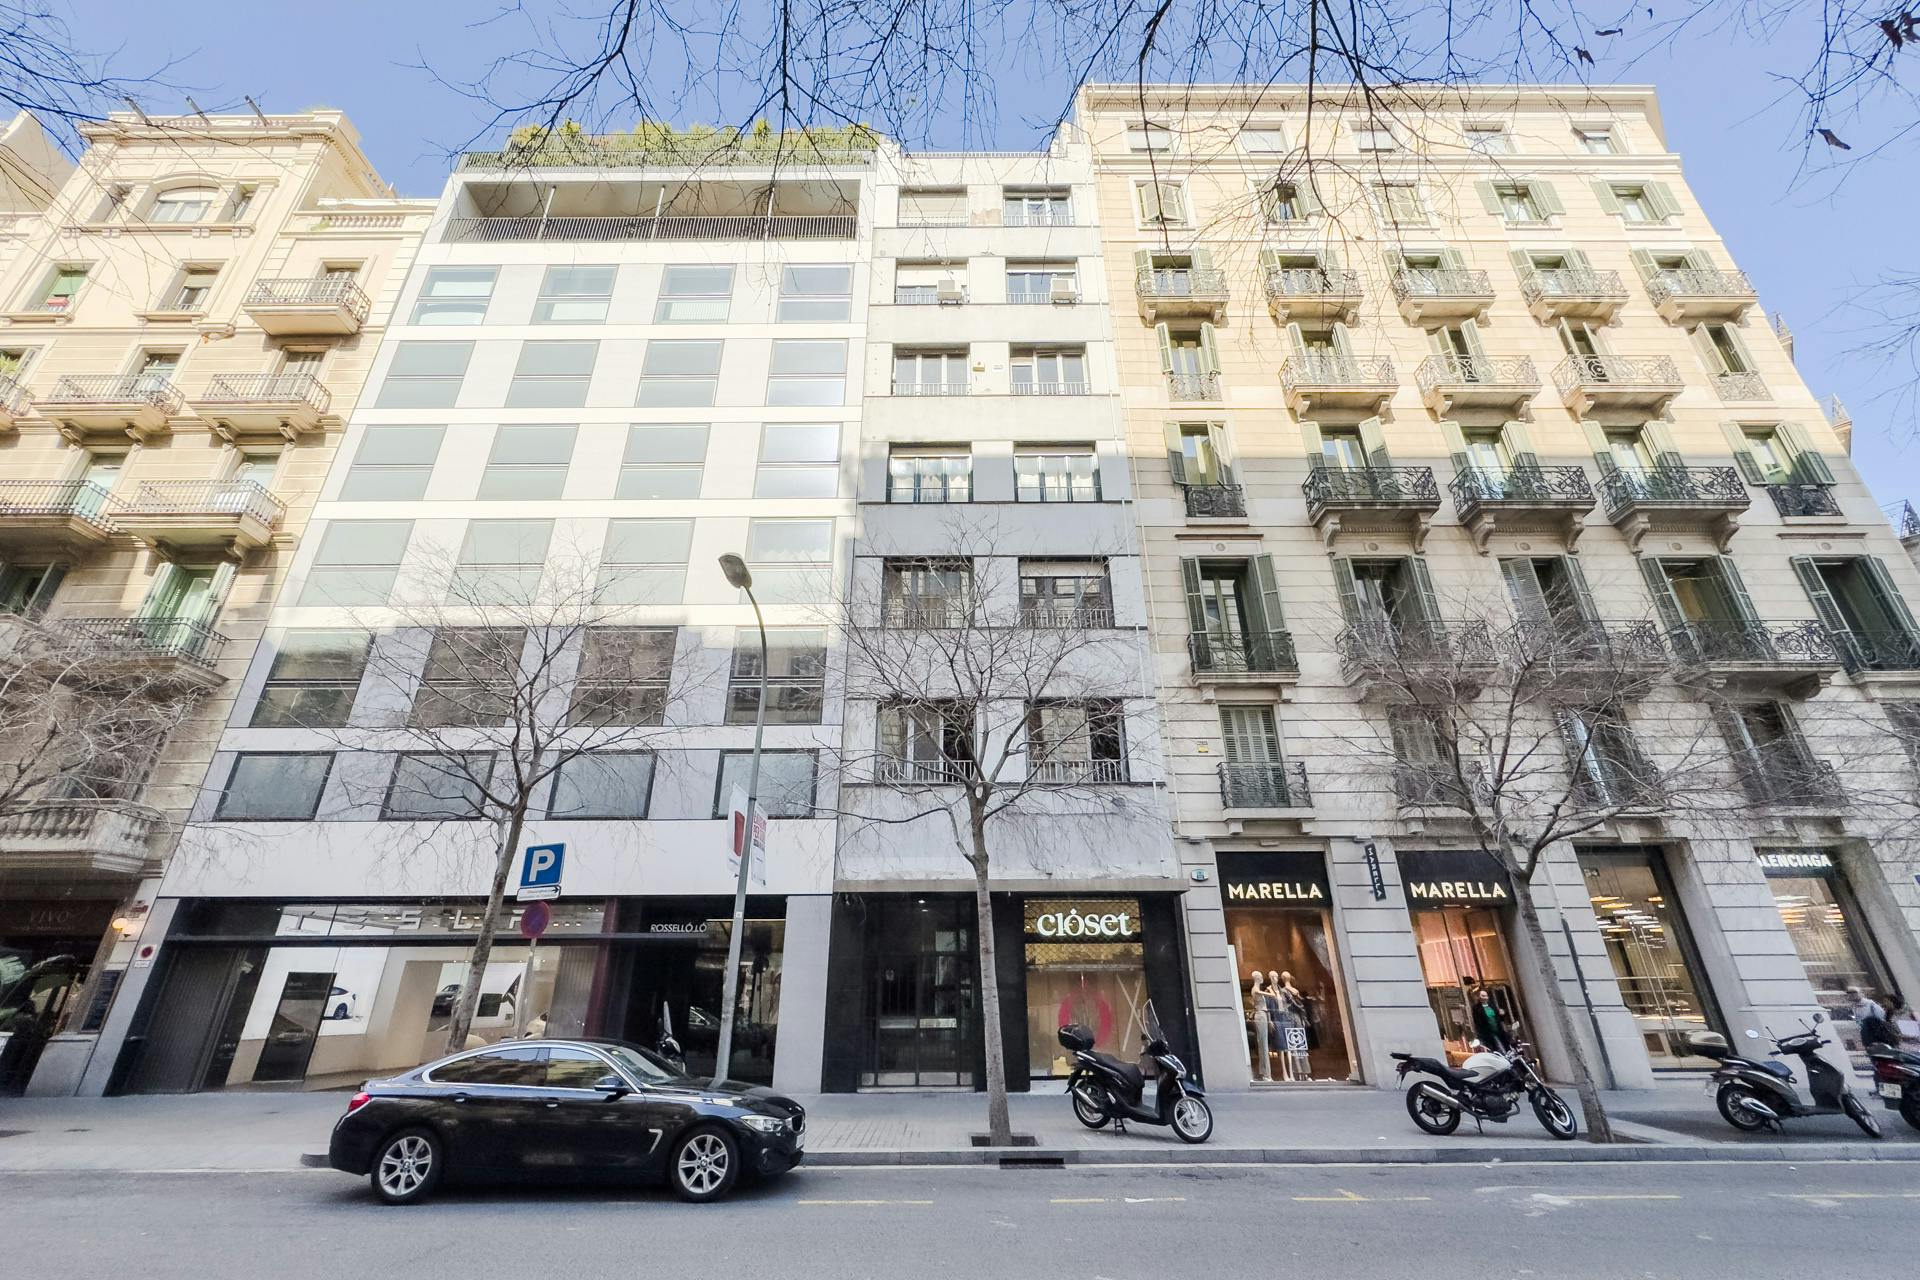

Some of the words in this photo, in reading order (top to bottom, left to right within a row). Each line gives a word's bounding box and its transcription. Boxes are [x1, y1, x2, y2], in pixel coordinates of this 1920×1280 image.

[528, 849, 556, 882] P
[1368, 847, 1382, 897] MARELLA
[1228, 882, 1323, 899] MARELLA
[1410, 882, 1507, 898] MARELLA
